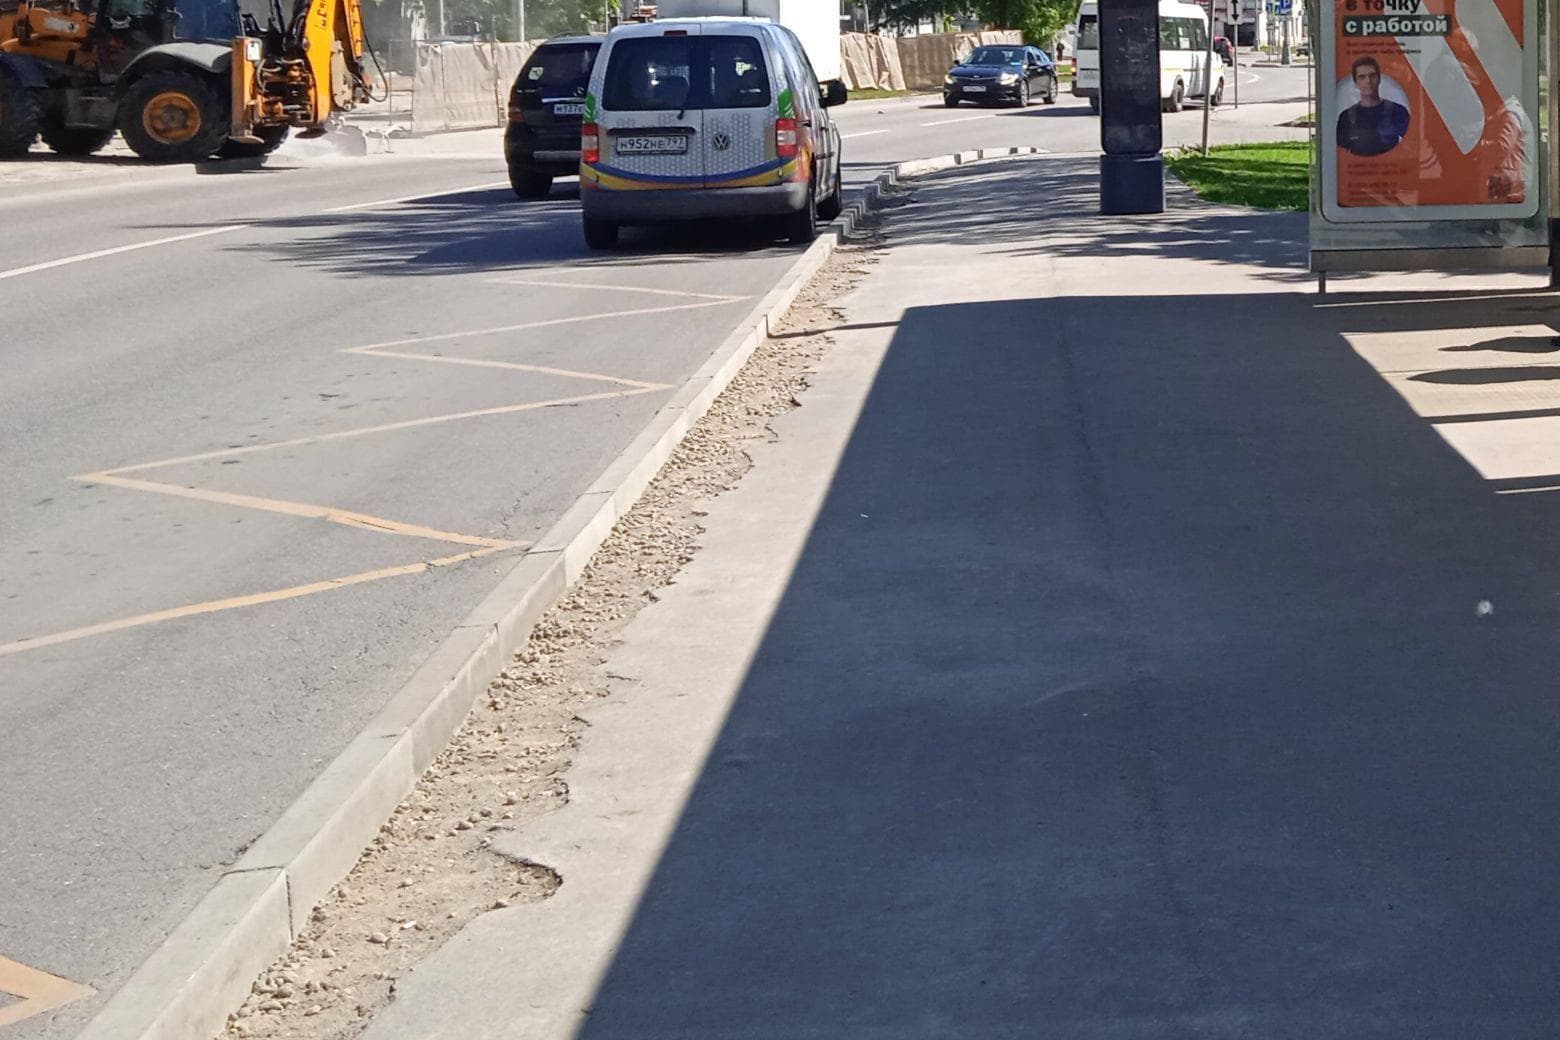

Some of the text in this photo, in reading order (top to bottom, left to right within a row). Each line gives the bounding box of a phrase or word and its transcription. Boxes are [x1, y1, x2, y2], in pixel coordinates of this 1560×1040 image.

[1346, 1, 1357, 10] в
[1346, 16, 1448, 36] с работой
[667, 137, 684, 146] 797
